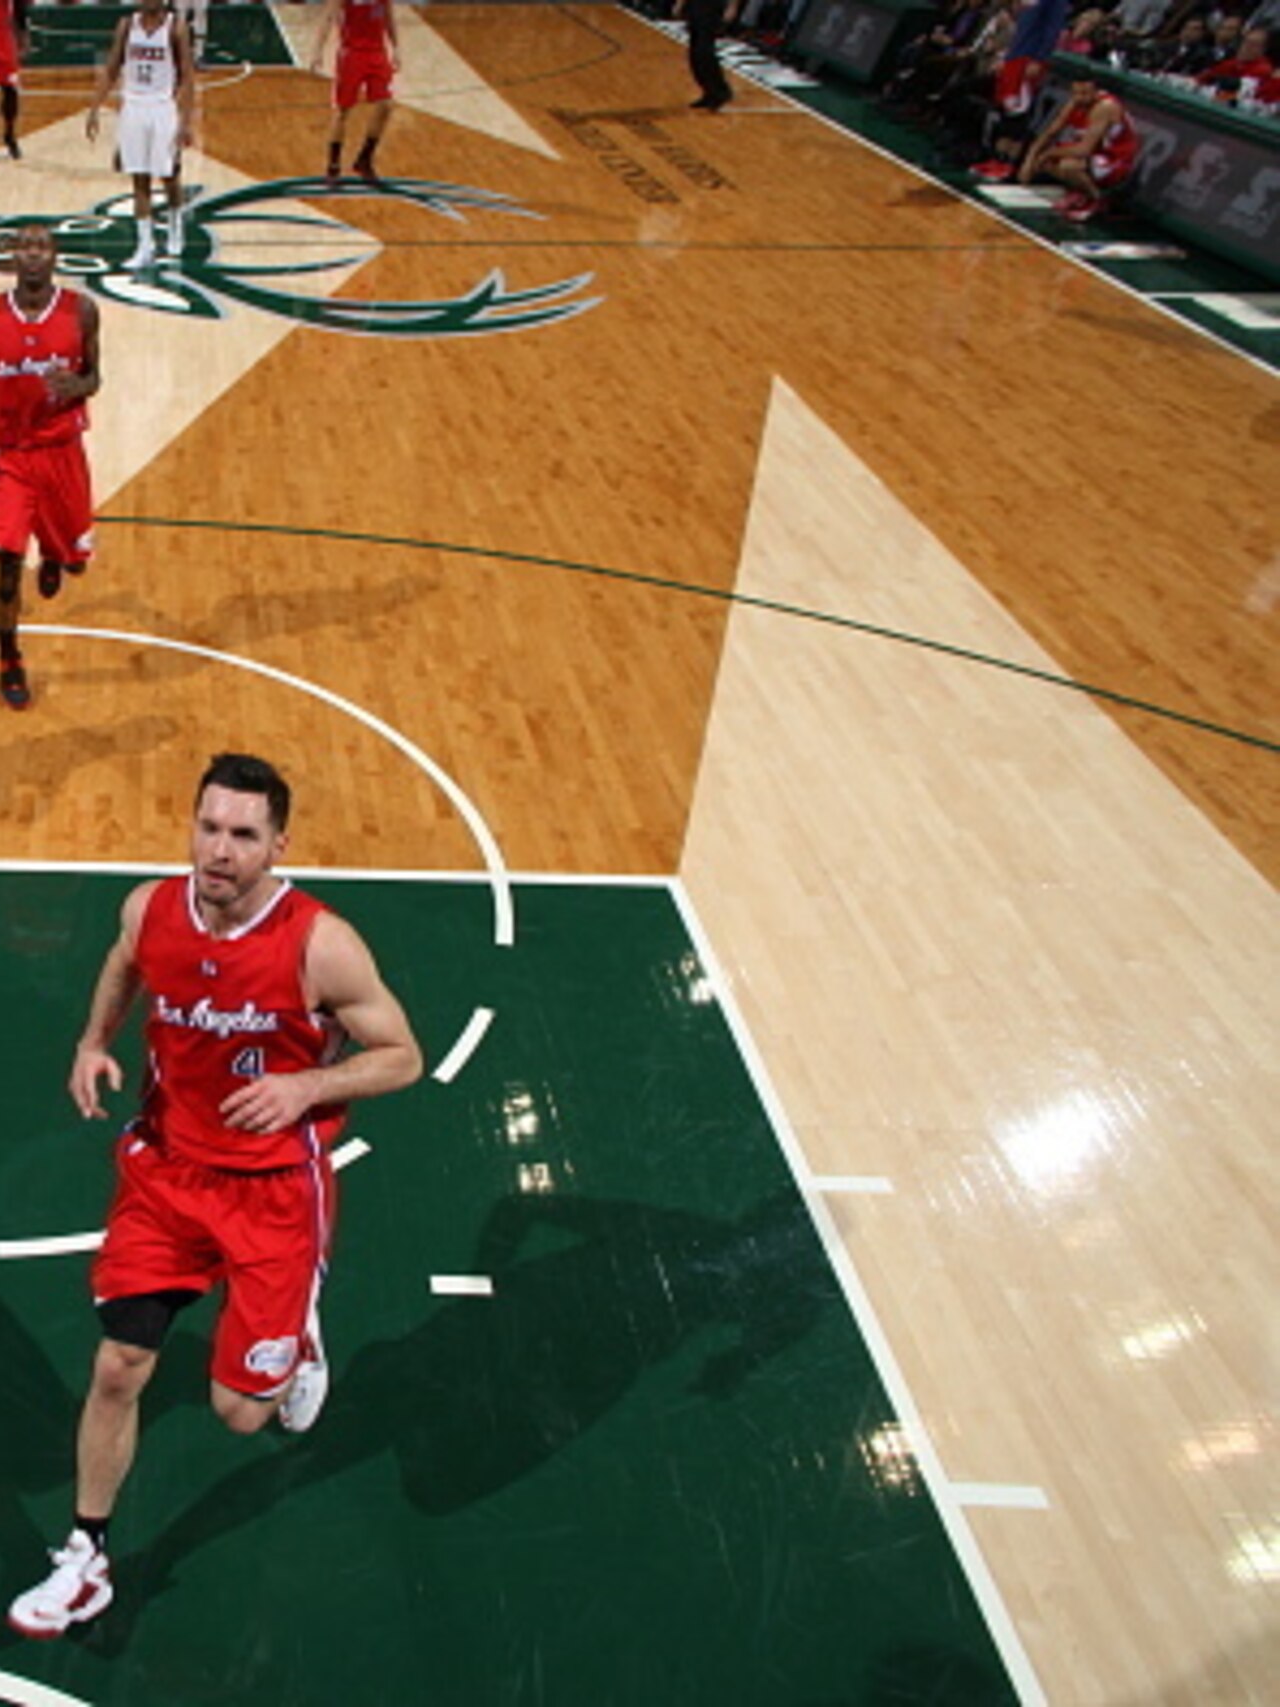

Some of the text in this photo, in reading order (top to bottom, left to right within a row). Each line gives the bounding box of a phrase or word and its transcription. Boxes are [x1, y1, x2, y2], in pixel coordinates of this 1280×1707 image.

[156, 995, 278, 1039] Los Angeles
[231, 1047, 265, 1080] 4
